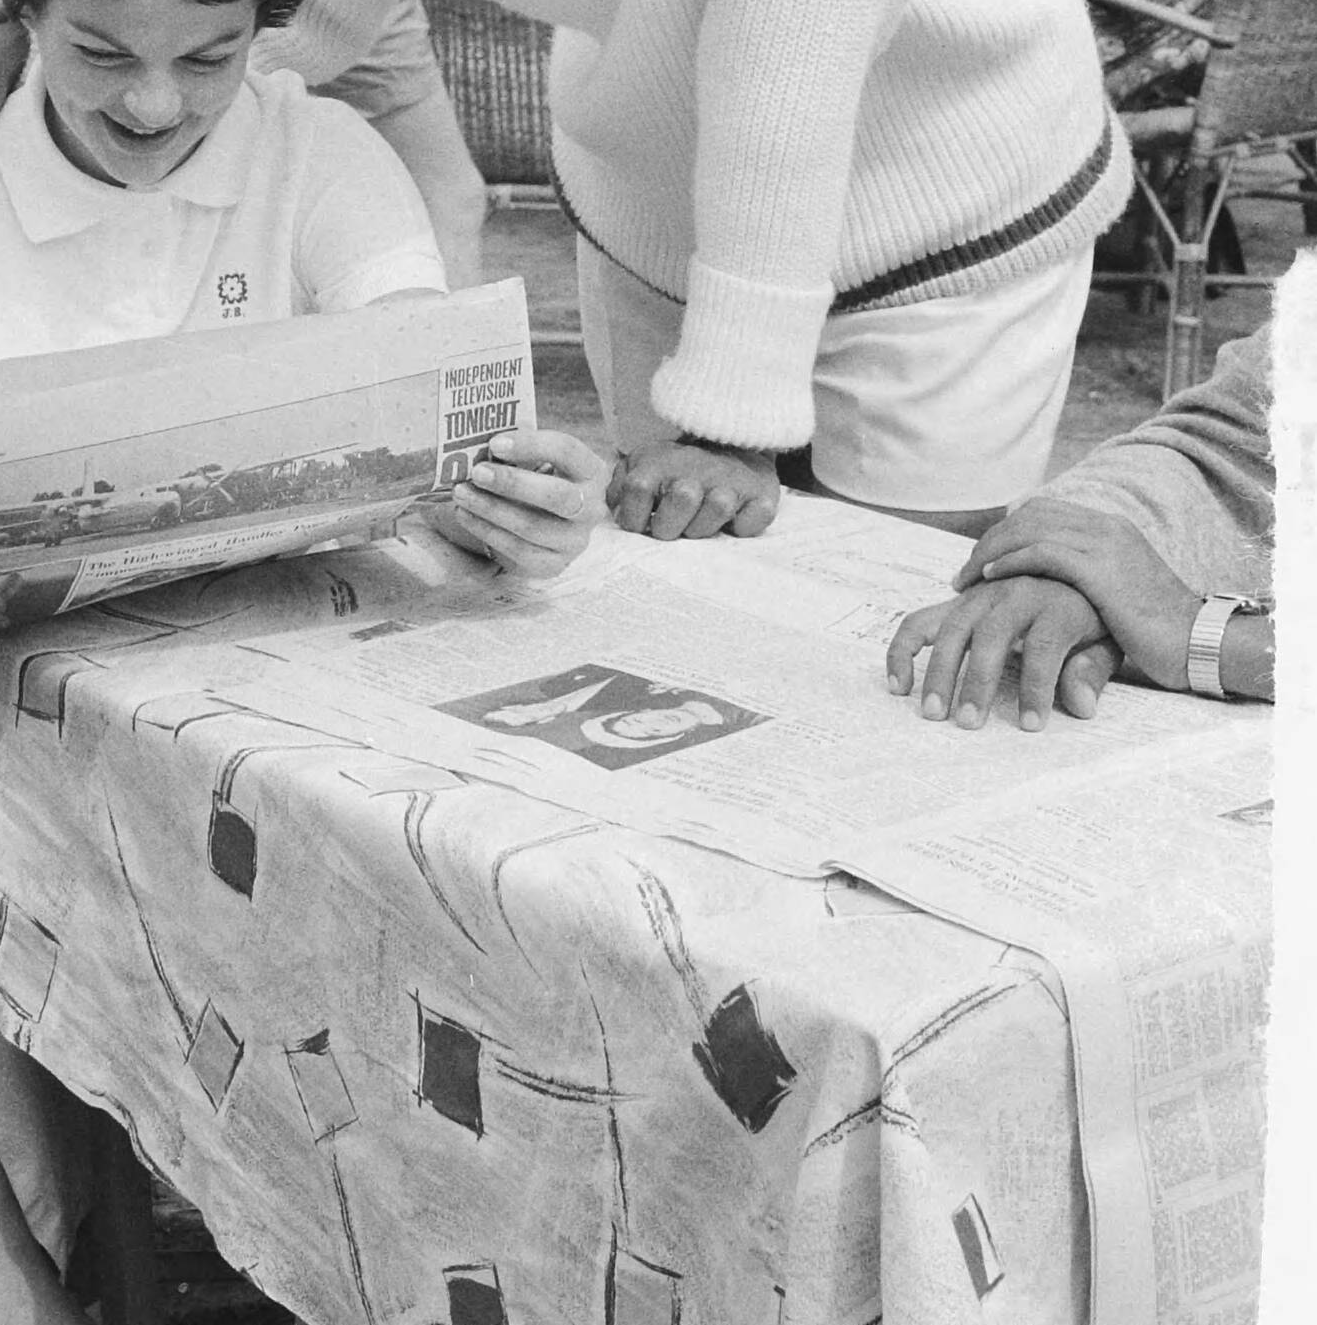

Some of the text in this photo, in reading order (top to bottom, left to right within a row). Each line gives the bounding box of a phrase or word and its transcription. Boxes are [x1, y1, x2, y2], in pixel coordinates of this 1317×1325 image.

[444, 357, 524, 389] INDEPENDENT
[451, 379, 515, 409] TELEVISION
[444, 399, 521, 440] TONIGHT
